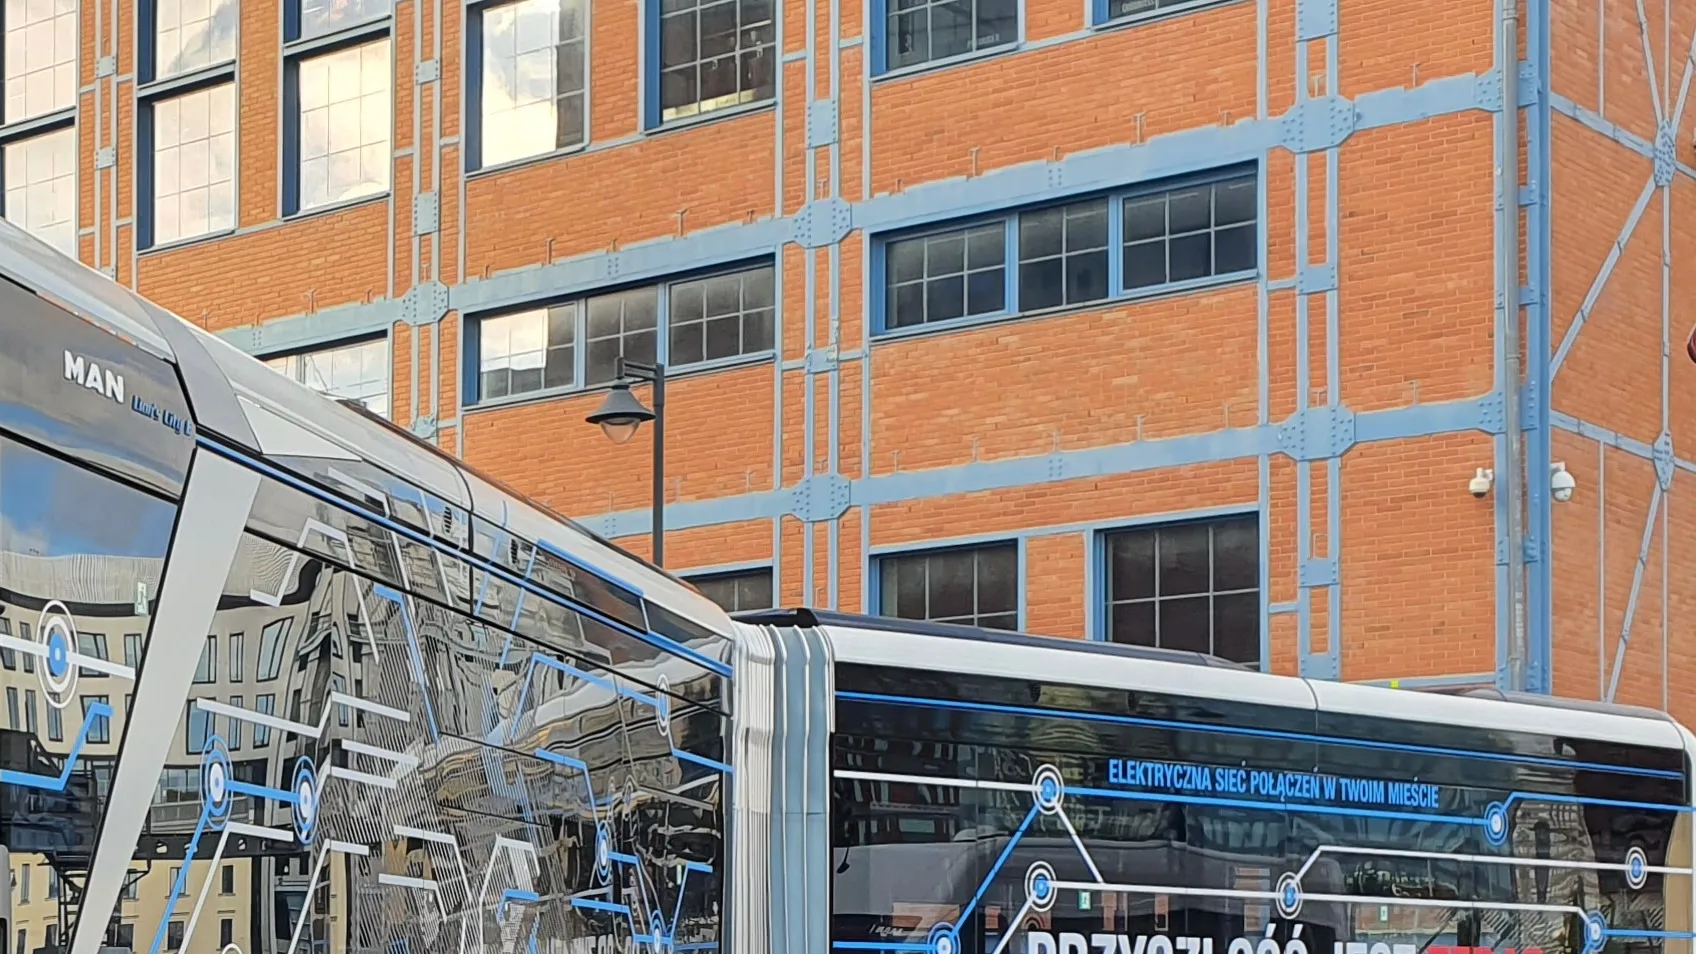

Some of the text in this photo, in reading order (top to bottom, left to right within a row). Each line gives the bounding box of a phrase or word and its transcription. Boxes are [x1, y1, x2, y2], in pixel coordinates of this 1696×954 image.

[64, 350, 124, 404] MAN
[162, 409, 183, 435] City
[1108, 758, 1439, 808] ELEKTRYCZNA SIEĆ POŁĄCZEŃ W TWOIM MIEŚCIE
